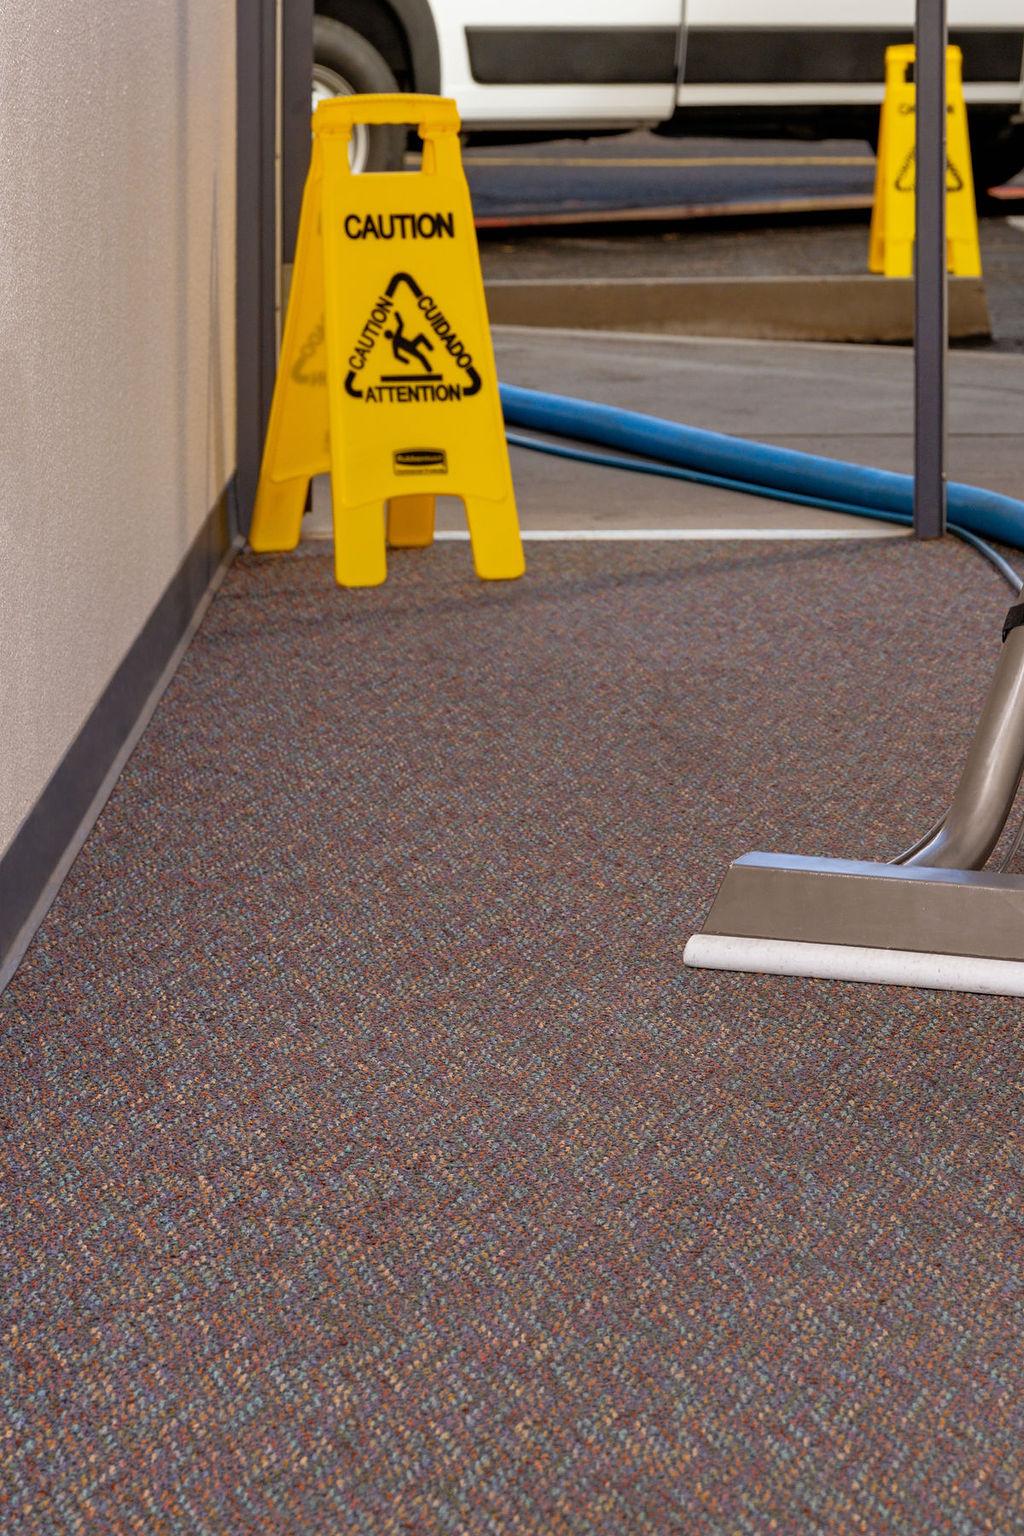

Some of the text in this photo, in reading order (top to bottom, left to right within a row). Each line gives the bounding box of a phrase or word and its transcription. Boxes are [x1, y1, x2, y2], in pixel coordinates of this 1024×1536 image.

[344, 213, 455, 239] CAUTION
[349, 295, 393, 370] CAUTION
[417, 295, 473, 368] CUIDADO
[365, 384, 462, 404] ATTENTION
